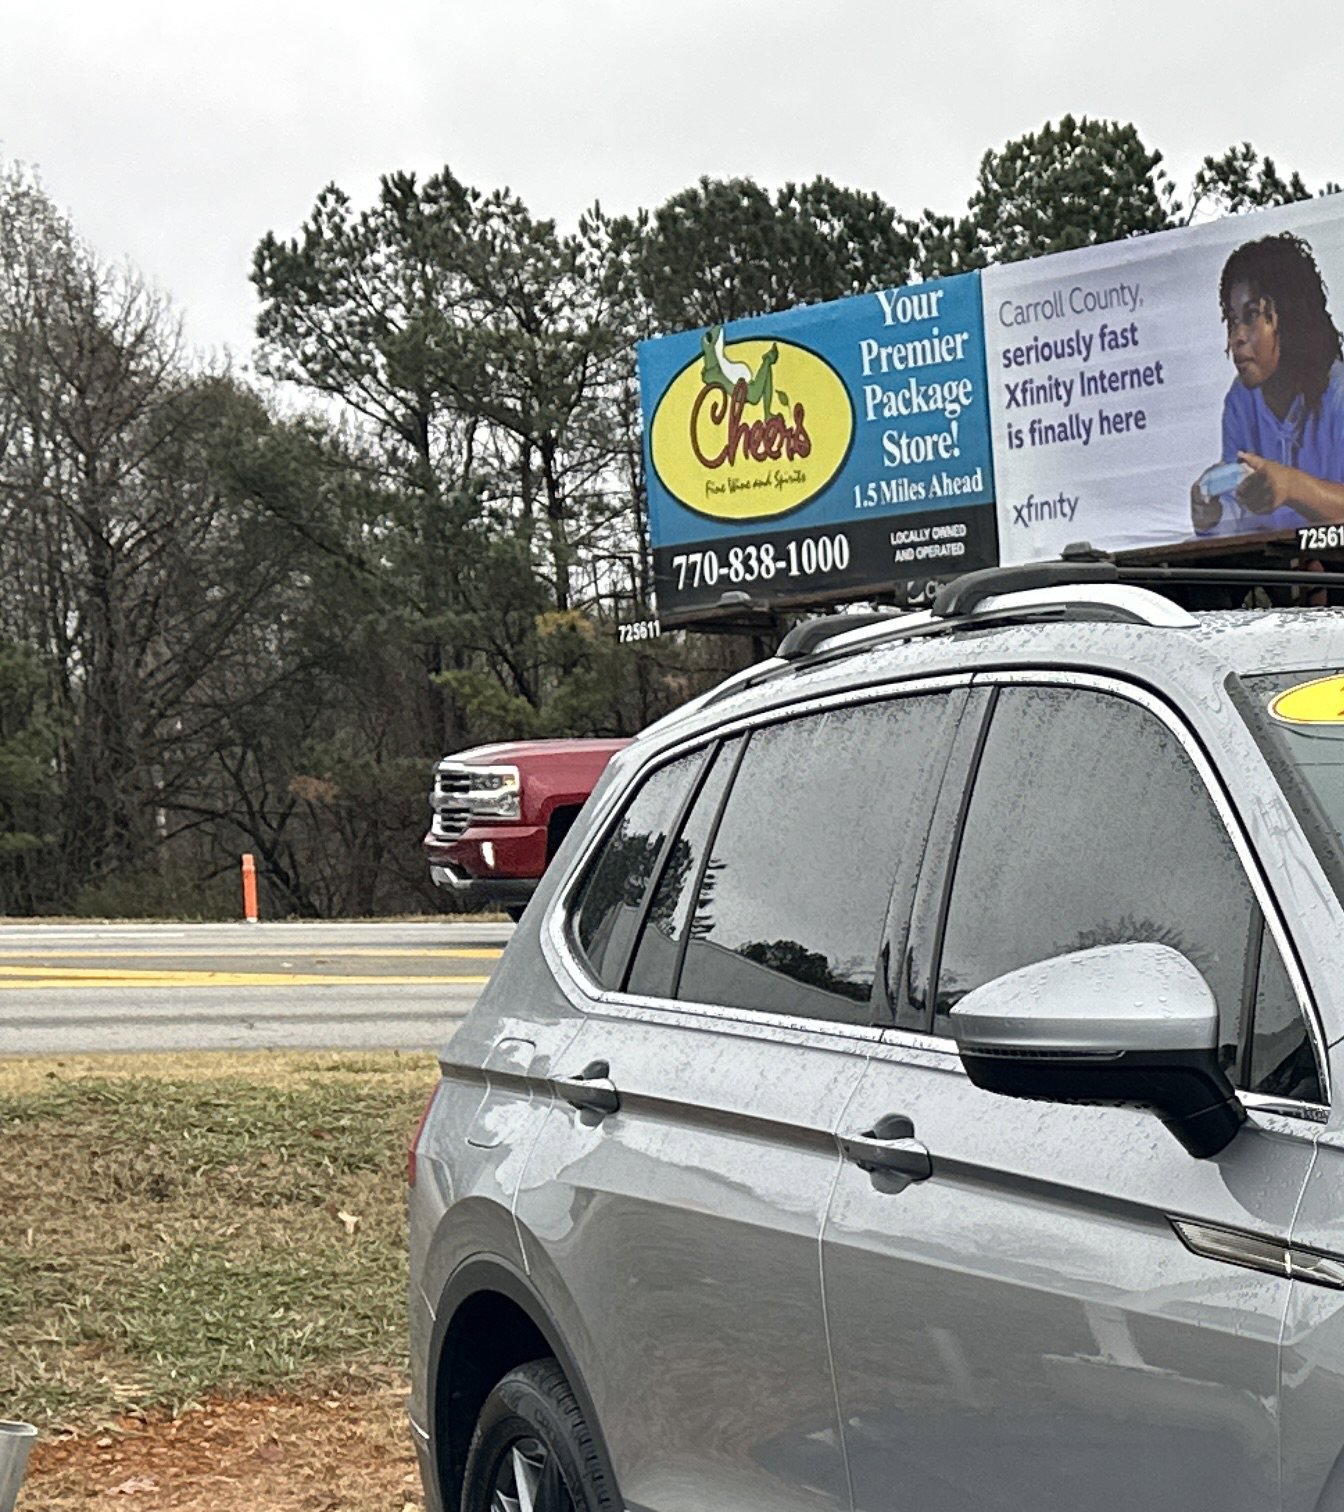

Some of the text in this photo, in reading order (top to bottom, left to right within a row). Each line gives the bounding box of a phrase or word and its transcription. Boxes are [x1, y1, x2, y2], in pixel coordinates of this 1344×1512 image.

[875, 287, 944, 328] Your
[999, 281, 1144, 328] Carroll County,
[859, 327, 969, 377] Premier
[1001, 321, 1139, 369] seriously fast
[863, 376, 974, 422] Package
[1004, 360, 1164, 409] Xfinity Internet
[690, 377, 812, 469] Cheers
[882, 420, 962, 468] Store!
[1007, 406, 1147, 450] is finally here
[853, 467, 984, 509] 1.5 Miles Ahead
[1012, 492, 1079, 528] xfinity
[890, 523, 967, 546] LOCALLY OWNED
[894, 542, 965, 562] AND OPERATED
[672, 533, 850, 591] 770-838-1000
[618, 619, 661, 643] 725611
